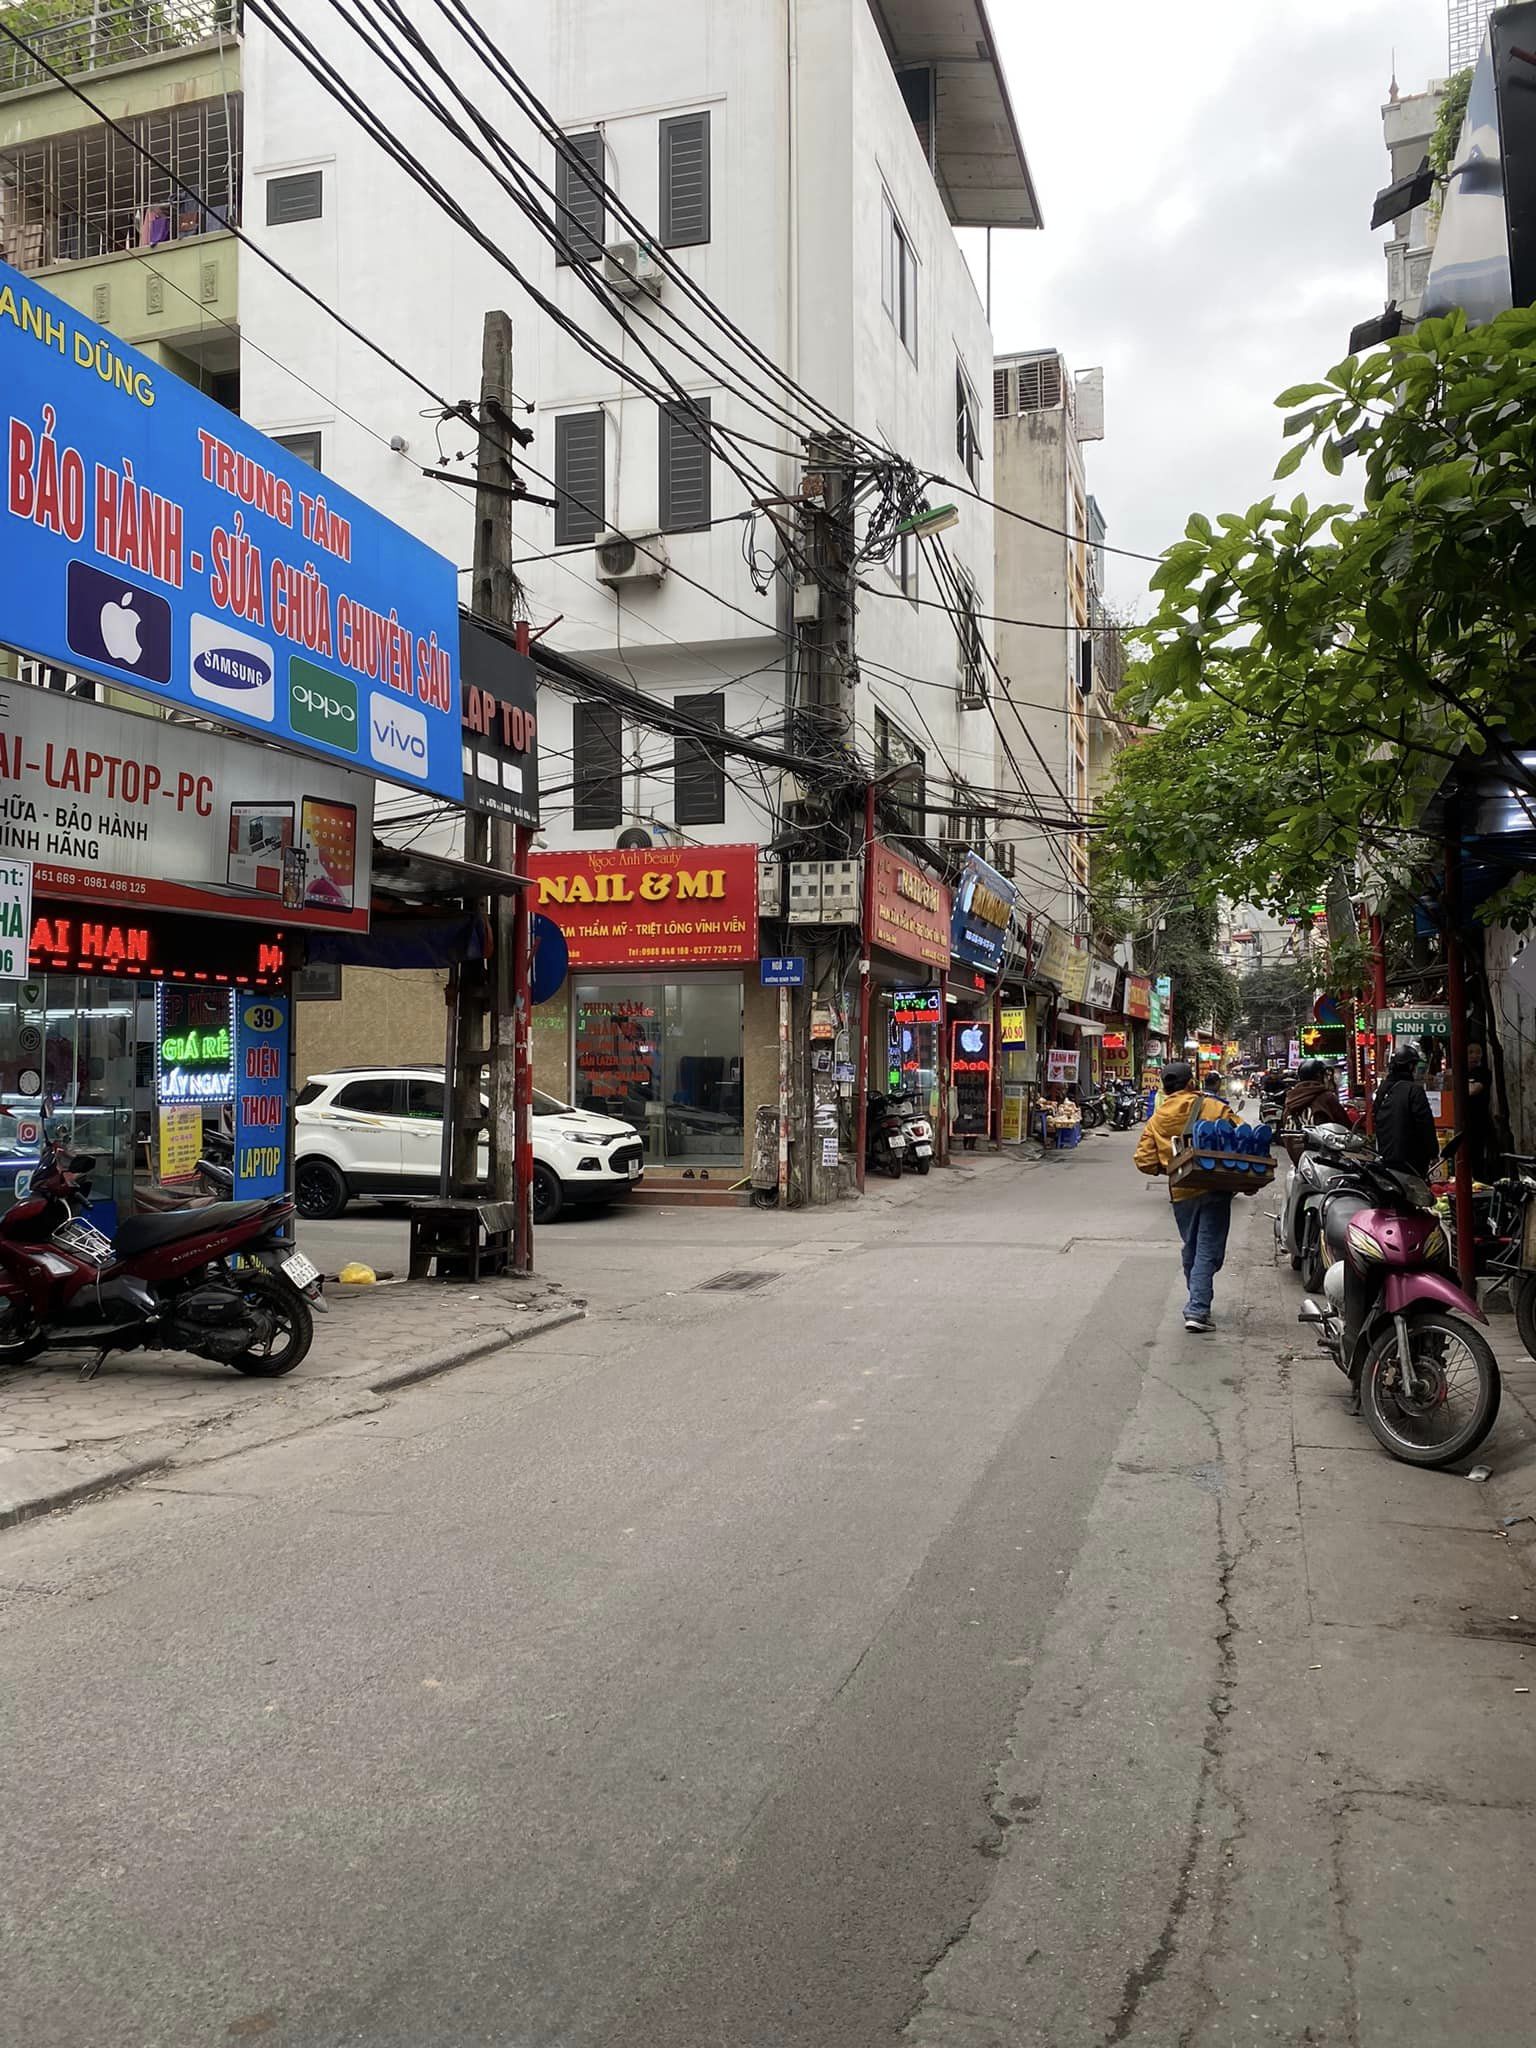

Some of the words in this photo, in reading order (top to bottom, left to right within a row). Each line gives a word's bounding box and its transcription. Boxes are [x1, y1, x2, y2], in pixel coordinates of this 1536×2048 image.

[0, 285, 66, 354] ANH
[73, 331, 155, 408] DŨNG
[198, 426, 293, 529] TRUNG
[299, 493, 350, 563] TÂM
[8, 403, 84, 544] BẢO
[95, 462, 184, 588] HÀNH
[210, 510, 265, 626] SỬA
[271, 557, 330, 663] CHỮA
[336, 592, 413, 697] CHUYÊN
[416, 632, 451, 715] SÂU
[203, 652, 264, 688] SAMSUNG
[291, 685, 355, 724] oppo
[373, 720, 425, 769] vivo
[502, 699, 536, 754] TOP
[56, 803, 93, 832] BẢO
[100, 812, 148, 841] HÀNH
[47, 829, 99, 860] HÃNG
[644, 850, 682, 868] Beauty
[538, 874, 635, 904] NAIL
[640, 872, 673, 900] &
[676, 869, 728, 899] MI
[579, 919, 609, 937] THẨM
[612, 921, 630, 936] MỸ
[636, 921, 661, 940] TRIỆT
[664, 919, 692, 935] LÔNG
[696, 918, 720, 934] VĨNH
[724, 914, 747, 932] VIỄN
[253, 1008, 275, 1029] 39
[1396, 1023, 1424, 1033] SINH
[162, 1030, 197, 1060] GIÁ
[202, 1028, 230, 1058] RẺ
[160, 1066, 190, 1096] LẤY
[190, 1073, 230, 1095] NGAY
[247, 1041, 280, 1086] ĐIỆN
[242, 1096, 282, 1134] THOẠI
[240, 1148, 281, 1178] LAPTOP
